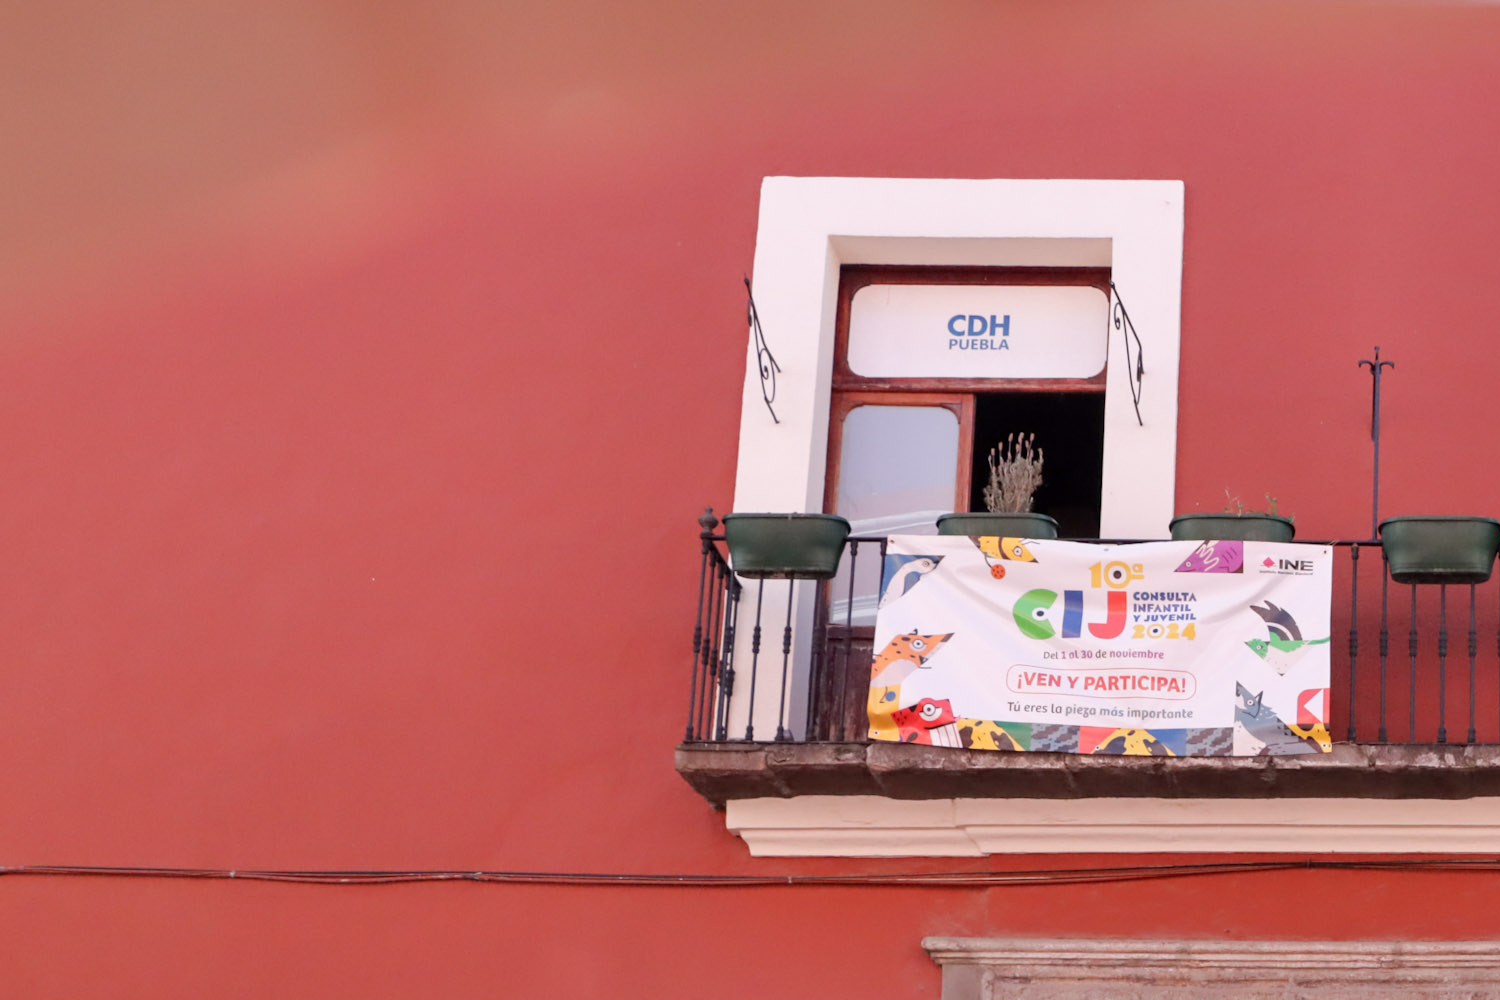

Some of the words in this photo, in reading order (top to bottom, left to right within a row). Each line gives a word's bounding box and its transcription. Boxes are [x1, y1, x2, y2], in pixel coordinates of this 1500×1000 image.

[947, 314, 1010, 337] CDH
[949, 339, 1010, 350] PUEBLA
[1279, 559, 1313, 571] INE
[1133, 591, 1197, 602] CONSULTA
[1133, 603, 1192, 612] INFANTIL
[1012, 588, 1128, 640] CIJ
[1133, 614, 1141, 622] Y
[1144, 613, 1196, 622] JUVENIL
[1131, 622, 1196, 640] 2024
[1043, 651, 1059, 660] Del
[1061, 651, 1067, 660] 1
[1068, 650, 1079, 659] al
[1081, 650, 1093, 659] 30
[1095, 649, 1107, 659] de
[1109, 649, 1165, 660] noviembre
[1017, 671, 1062, 690] ¡VEN
[1067, 676, 1080, 689] Y
[1083, 675, 1187, 693] PARTICIPA!
[1007, 701, 1021, 712] Tú
[1023, 703, 1048, 713] eres
[1051, 703, 1062, 714] la
[1065, 703, 1097, 718] pieza
[1099, 706, 1124, 717] más
[1127, 707, 1194, 721] importante
